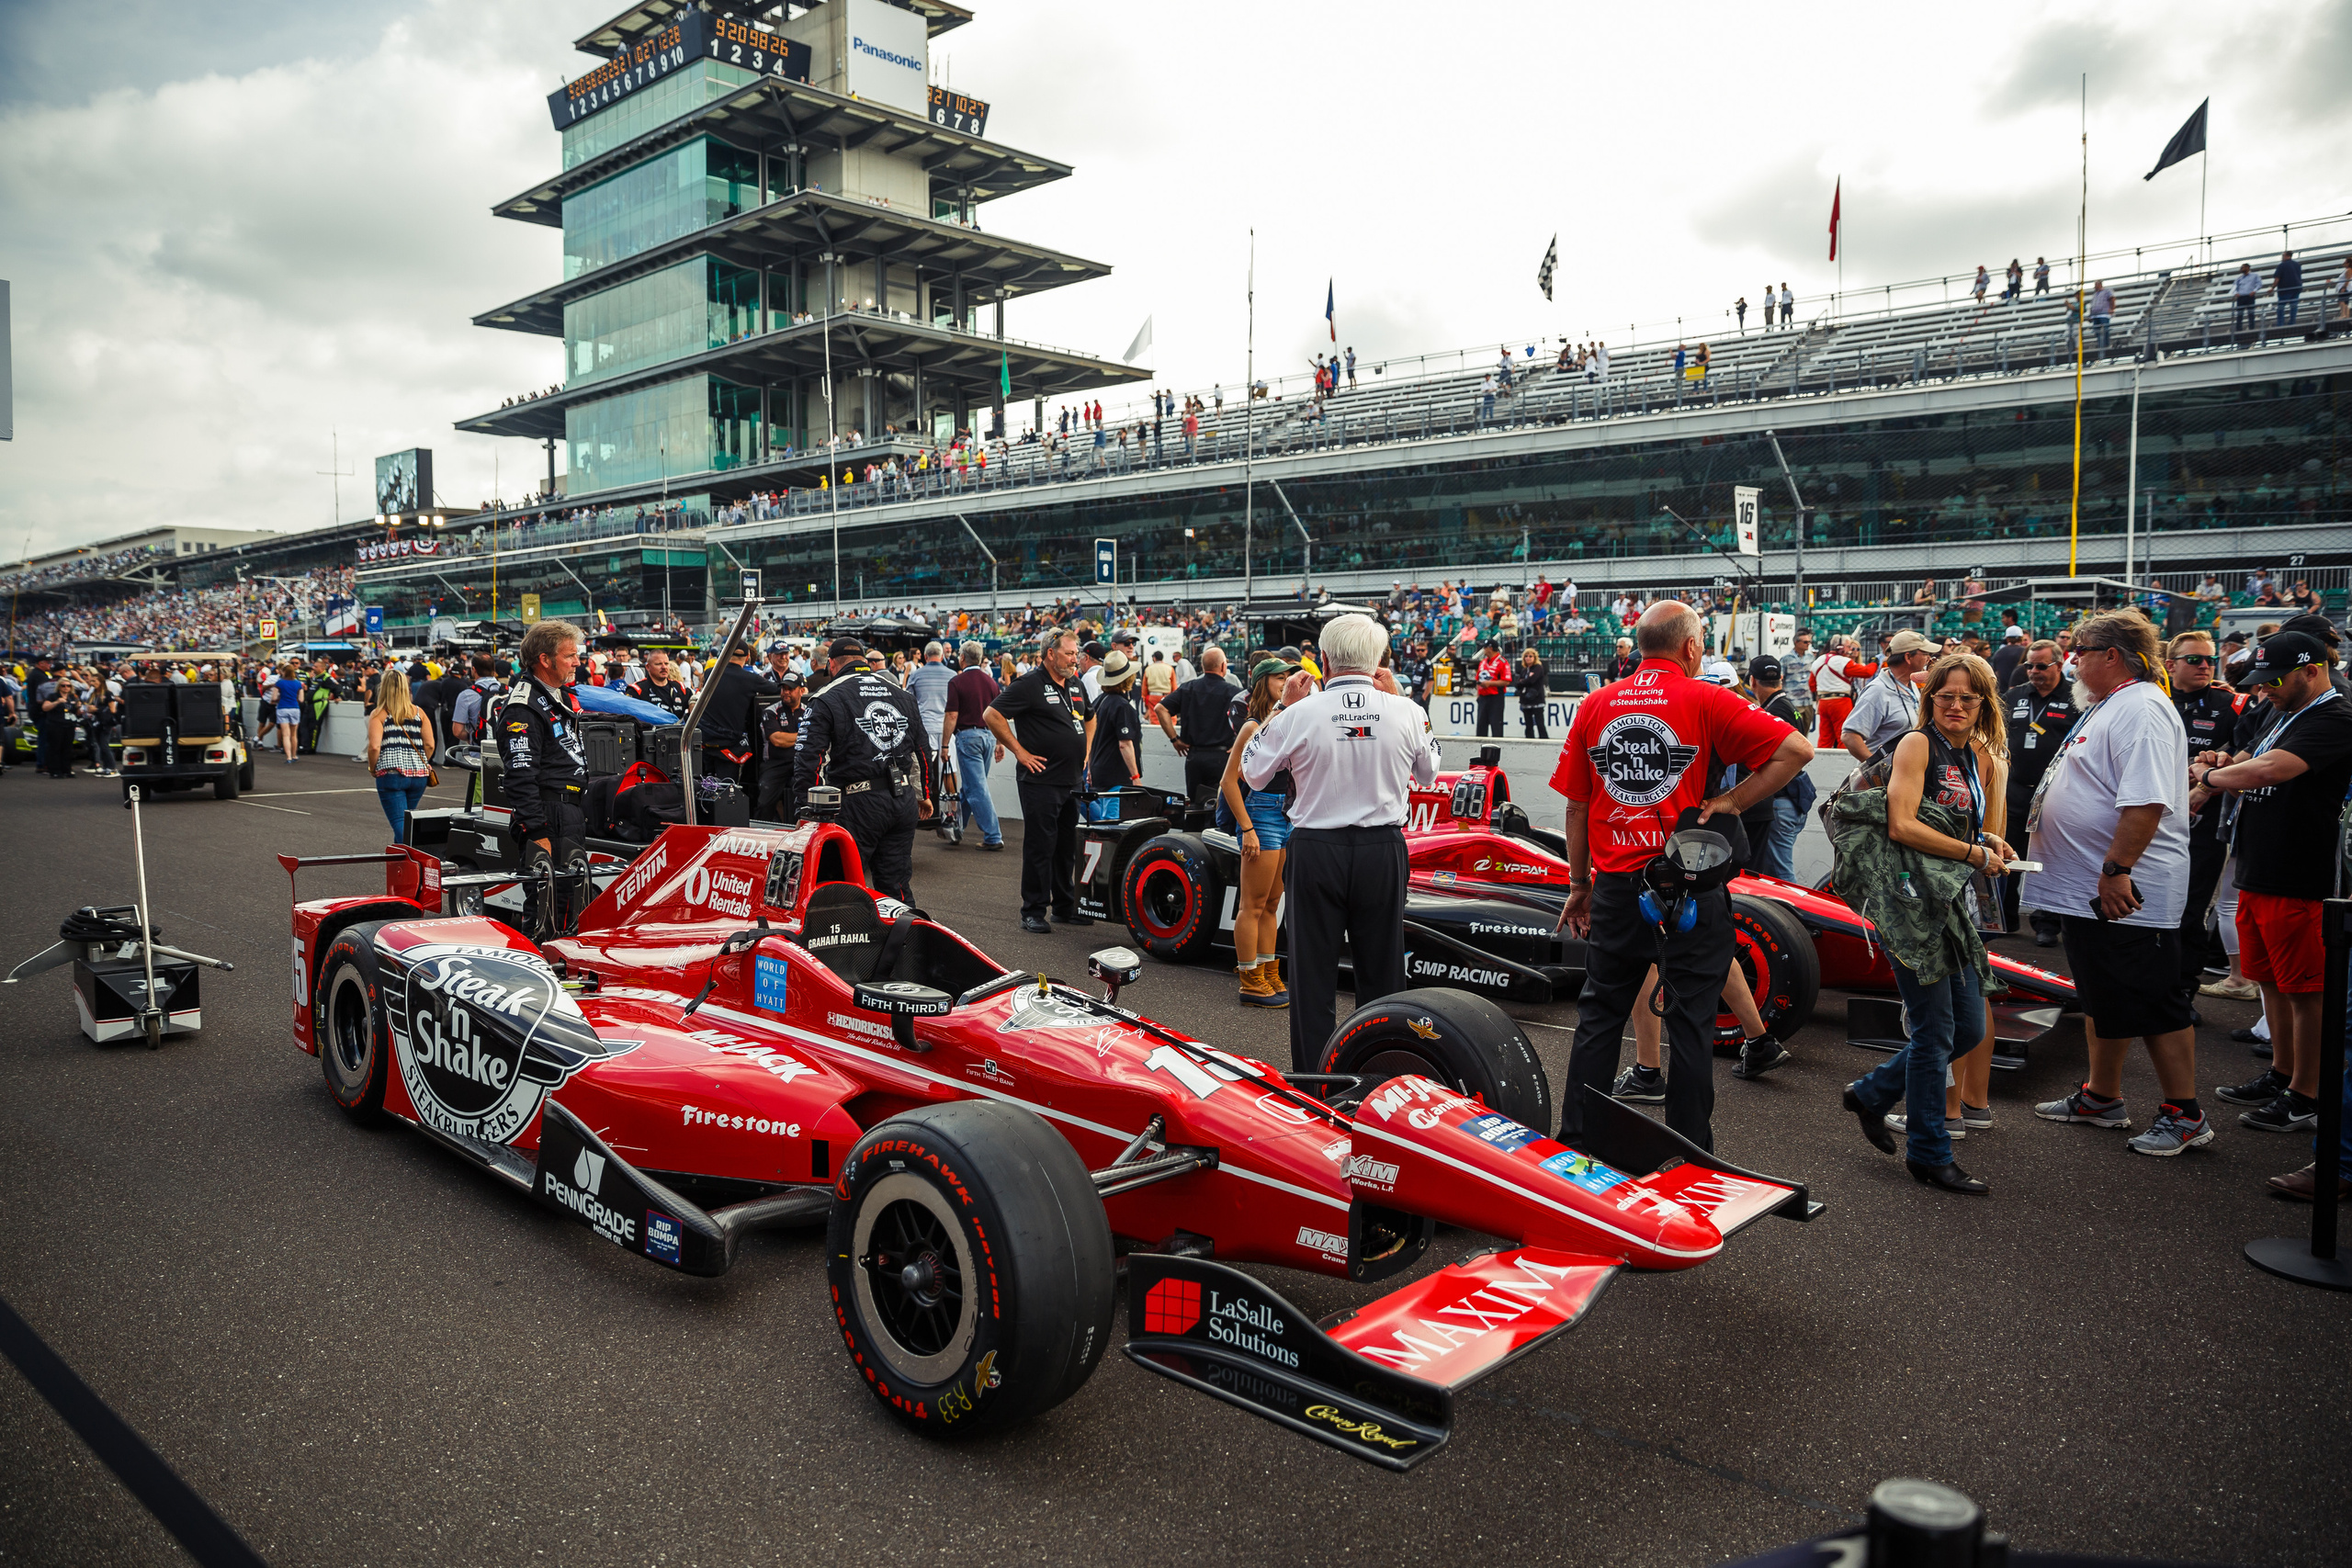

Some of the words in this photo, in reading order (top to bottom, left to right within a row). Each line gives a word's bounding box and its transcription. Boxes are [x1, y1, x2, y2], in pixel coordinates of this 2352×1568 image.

[728, 22, 747, 44] 20
[750, 29, 768, 51] 98
[770, 36, 788, 57] 26
[710, 38, 718, 57] 1
[730, 44, 741, 63] 2
[752, 51, 763, 69] 3
[773, 58, 783, 75] 4
[853, 36, 922, 71] Panasonic
[579, 98, 587, 115] 2
[590, 92, 598, 108] 3
[602, 85, 609, 102] 4
[613, 80, 620, 96] 5
[625, 73, 632, 91] 6
[636, 67, 642, 85] 7
[648, 61, 656, 78] 8
[661, 54, 668, 72] 9
[671, 45, 684, 66] 10
[936, 108, 945, 125] 6
[954, 113, 963, 129] 7
[970, 118, 979, 135] 8
[1738, 501, 1755, 525] 16
[2290, 555, 2305, 566] 27
[2296, 651, 2311, 664] 26
[1609, 696, 1668, 707] @SteaknShake
[1617, 687, 1664, 697] @RLLracing
[872, 712, 896, 724] Steak
[1331, 713, 1380, 723] @RLLracing
[1606, 716, 1644, 737] FAMOUS
[1644, 717, 1668, 736] FOR
[1611, 735, 1662, 757] Steak
[1611, 761, 1666, 783] Shake
[1408, 781, 1451, 794] NDA
[1603, 774, 1674, 803] STEAKBURGERS
[1080, 840, 1103, 885] 7
[1495, 861, 1549, 876] ZYPPAH
[615, 841, 668, 912] KEIHIN
[711, 871, 754, 897] United
[707, 891, 752, 919] Rentals
[1078, 907, 1107, 919] Firestone
[389, 920, 439, 932] STEAK
[830, 924, 841, 934] 15
[1469, 921, 1547, 936] Firestone
[808, 934, 839, 950] GRAHAM
[841, 933, 871, 944] RAHAL
[757, 960, 786, 976] WORLD
[1413, 960, 1447, 976] SMP
[1448, 964, 1510, 988] RACING
[420, 957, 539, 1017] Steak
[756, 993, 785, 1009] HYATT
[861, 994, 893, 1011] FIFTH
[897, 1000, 937, 1014] THIRD
[1340, 1024, 1364, 1047] INDY
[1364, 1016, 1389, 1028] 500
[416, 1010, 508, 1090] Shake
[684, 1028, 820, 1085] MI-JACK
[966, 1068, 982, 1078] FIFTH
[982, 1072, 999, 1083] THIRD
[999, 1077, 1015, 1088] BANK
[1371, 1077, 1450, 1122] MI-JAC
[680, 1104, 801, 1138] Firestone
[1477, 1116, 1503, 1129] RIP
[1478, 1120, 1525, 1142] BOMPA
[862, 1139, 975, 1206] FIREHAWK
[1586, 1170, 1622, 1190] HYATT
[1351, 1177, 1380, 1191] Works,
[1381, 1184, 1395, 1193] L.P.
[1675, 1173, 1762, 1217] XIM
[546, 1171, 635, 1241] PENNGRADE
[1616, 1188, 1660, 1212] dallara
[593, 1223, 613, 1241] MOTOR
[613, 1235, 624, 1247] OIL
[648, 1226, 680, 1247] BOMPA
[655, 1219, 672, 1233] RIP
[1322, 1252, 1347, 1265] Crane
[1209, 1289, 1284, 1336] LaSalle
[1359, 1254, 1573, 1372] MAXIM
[1209, 1319, 1300, 1369] Solutions
[1305, 1404, 1358, 1435] Crown
[1354, 1420, 1418, 1451] Royal
